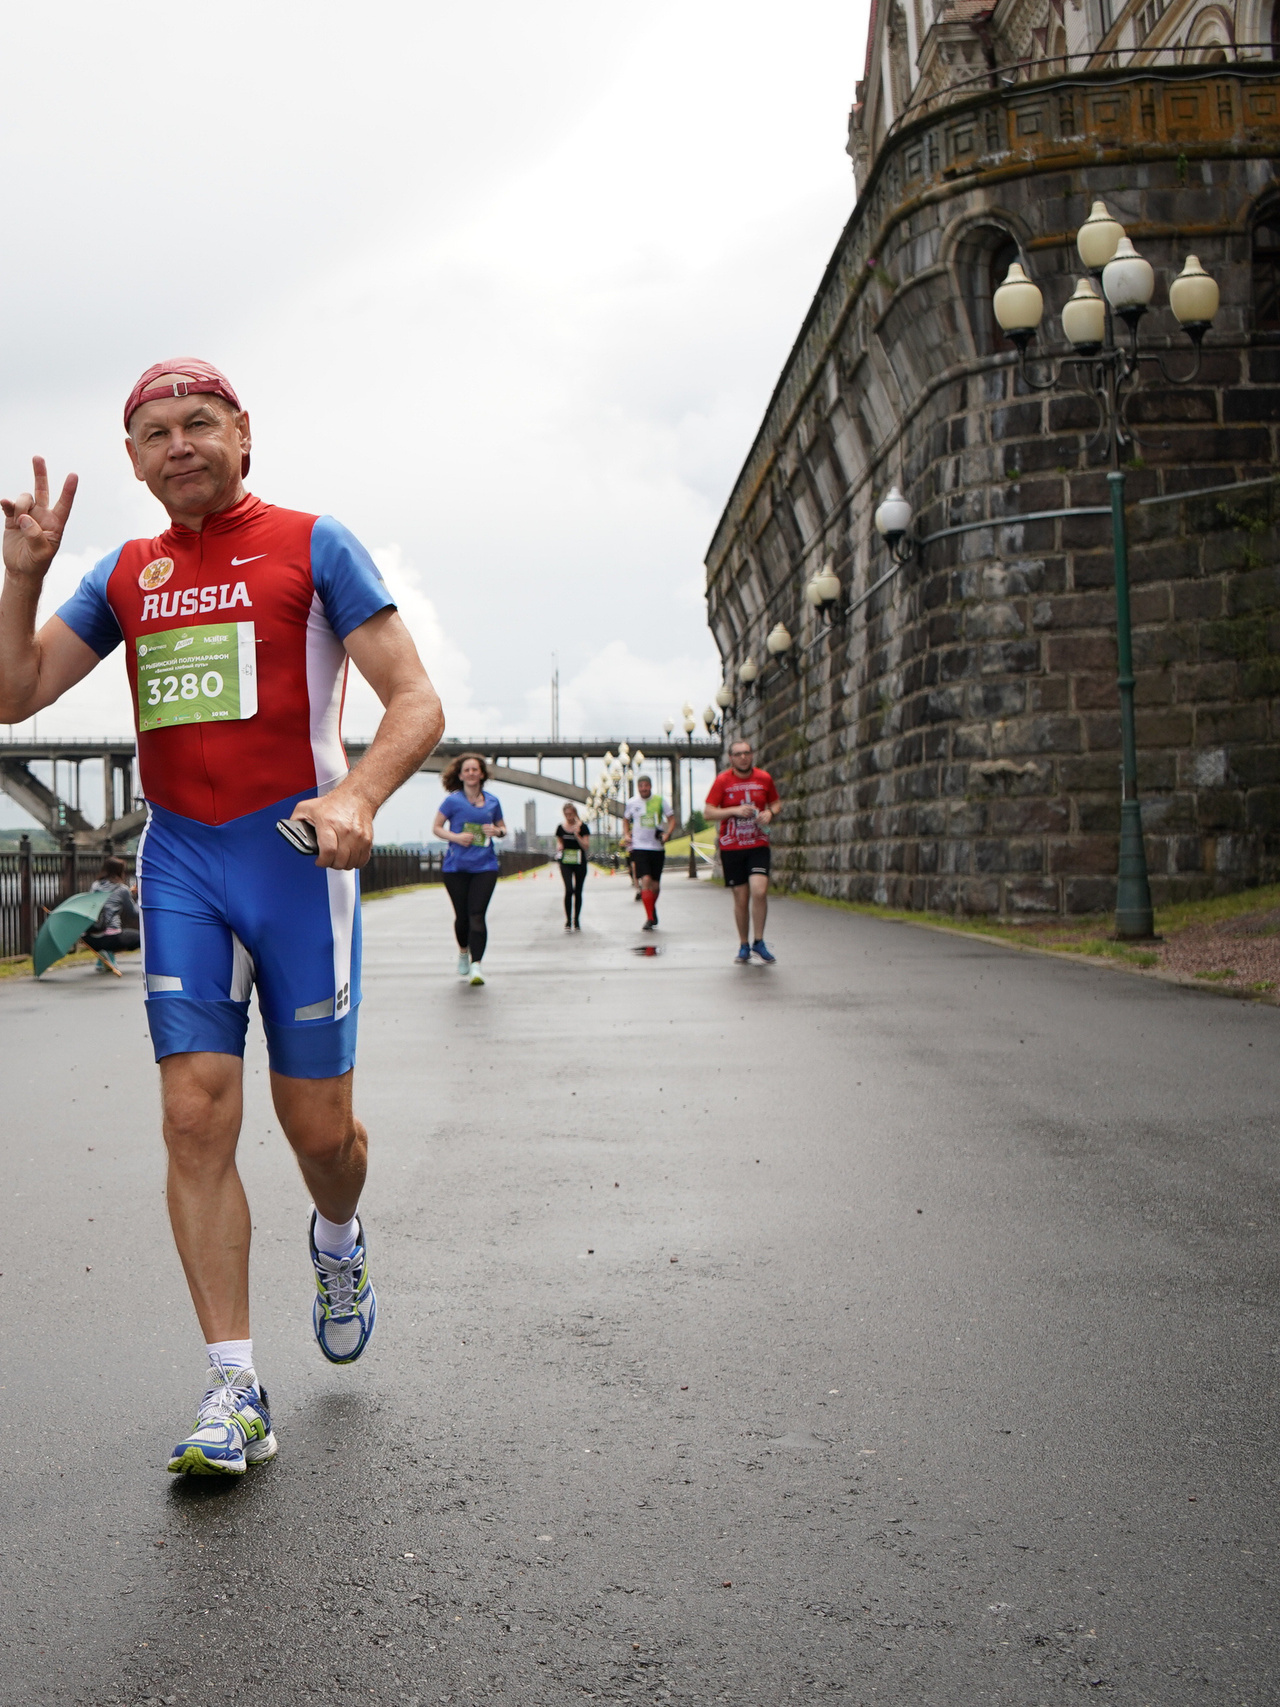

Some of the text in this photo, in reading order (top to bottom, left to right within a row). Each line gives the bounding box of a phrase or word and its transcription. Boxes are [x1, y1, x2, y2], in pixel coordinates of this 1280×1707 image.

[141, 581, 253, 622] RUSSIA
[179, 653, 229, 664] ПОЛУМАРАФОН
[147, 670, 224, 706] 3280
